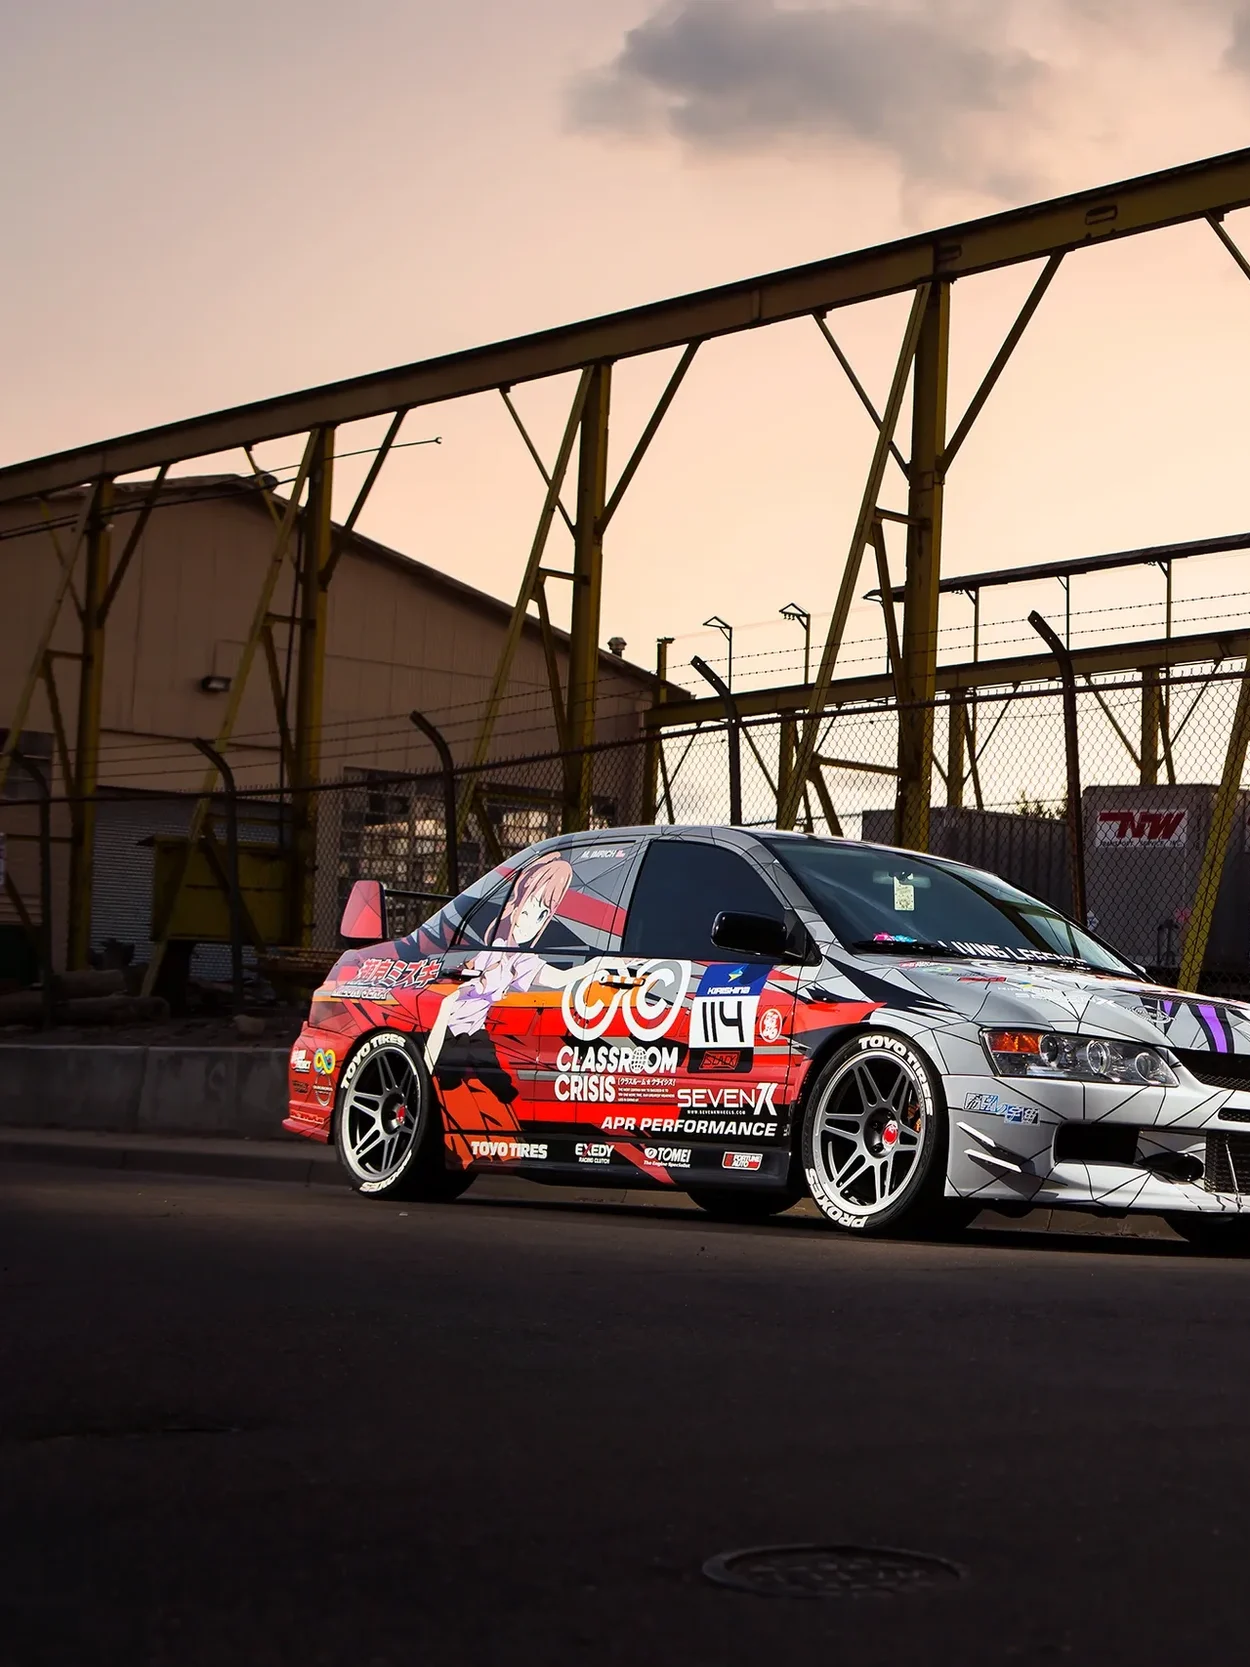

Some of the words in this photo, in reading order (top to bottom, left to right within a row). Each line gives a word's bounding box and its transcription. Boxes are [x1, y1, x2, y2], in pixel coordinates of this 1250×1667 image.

[702, 1000, 745, 1043] 114
[340, 1042, 371, 1089] TOYO
[370, 1033, 406, 1048] TIRES
[556, 1045, 679, 1074] CLASSROOM
[554, 1074, 616, 1103] CRISIS
[858, 1035, 907, 1057] TOYO
[905, 1051, 934, 1116] TIRES
[601, 1116, 636, 1132] APR
[640, 1118, 778, 1138] PERFORMANCE
[470, 1141, 508, 1157] TOYO
[509, 1142, 548, 1159] TIRES
[575, 1143, 615, 1157] EXEDY
[657, 1147, 692, 1163] TOMEI
[804, 1168, 870, 1229] PROXES
